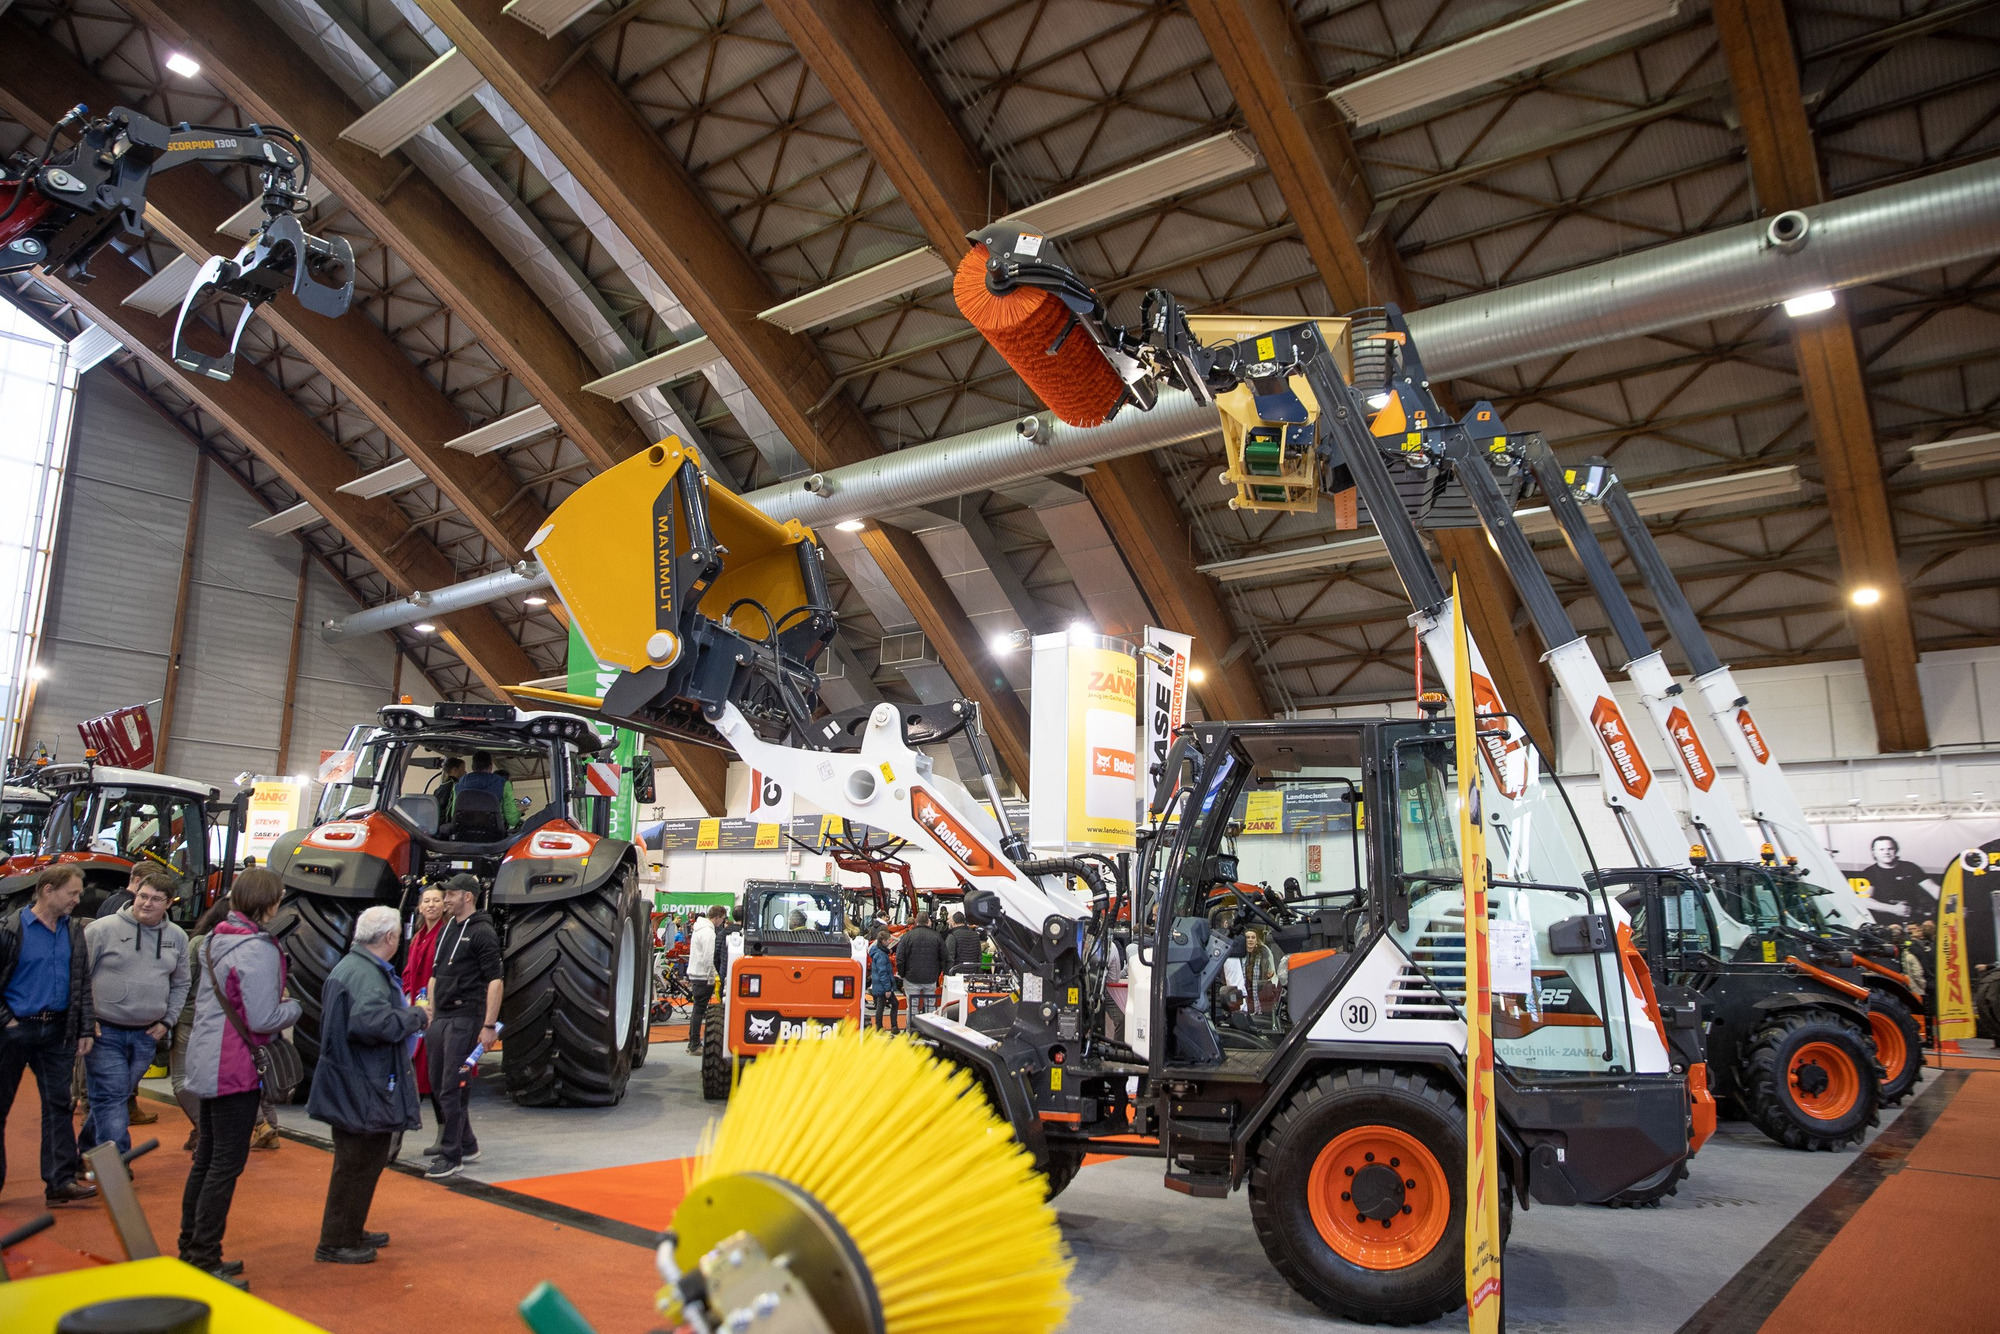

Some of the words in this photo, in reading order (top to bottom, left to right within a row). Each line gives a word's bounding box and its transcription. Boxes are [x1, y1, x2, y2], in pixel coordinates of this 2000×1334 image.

[167, 140, 215, 151] SCORPION
[215, 139, 237, 148] 1300
[658, 515, 671, 612] MAMMUT
[1088, 671, 1136, 700] ZANK
[1172, 656, 1186, 730] AGRICULTURE
[1154, 682, 1171, 765] ASE
[1747, 734, 1765, 757] Bobcat
[1113, 758, 1135, 776] Bobca
[1610, 740, 1642, 785] Bobcat
[1682, 743, 1708, 780] Bobcat
[1286, 792, 1328, 800] Landtechnik
[934, 820, 973, 862] Bobcat
[670, 903, 731, 917] PÖTTINGR
[1538, 988, 1572, 1005] 85
[1349, 1004, 1368, 1024] 30
[780, 1020, 839, 1040] Bobcat
